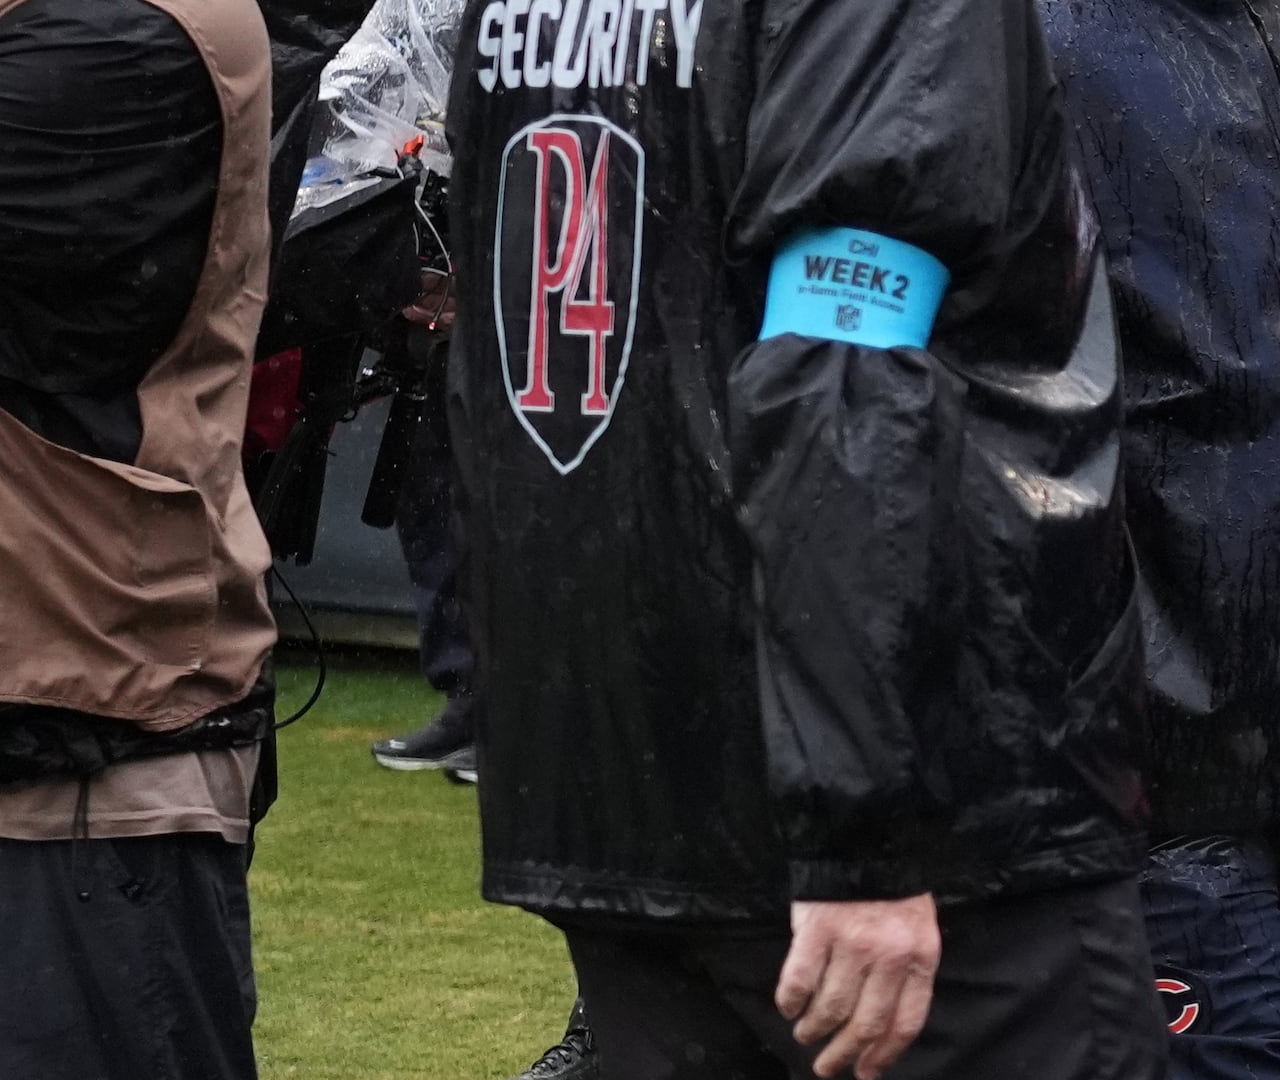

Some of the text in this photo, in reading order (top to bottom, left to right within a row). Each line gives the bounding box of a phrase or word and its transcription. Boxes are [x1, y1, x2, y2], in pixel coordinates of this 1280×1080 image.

[515, 127, 615, 416] P4
[804, 254, 911, 301] WEEK 2
